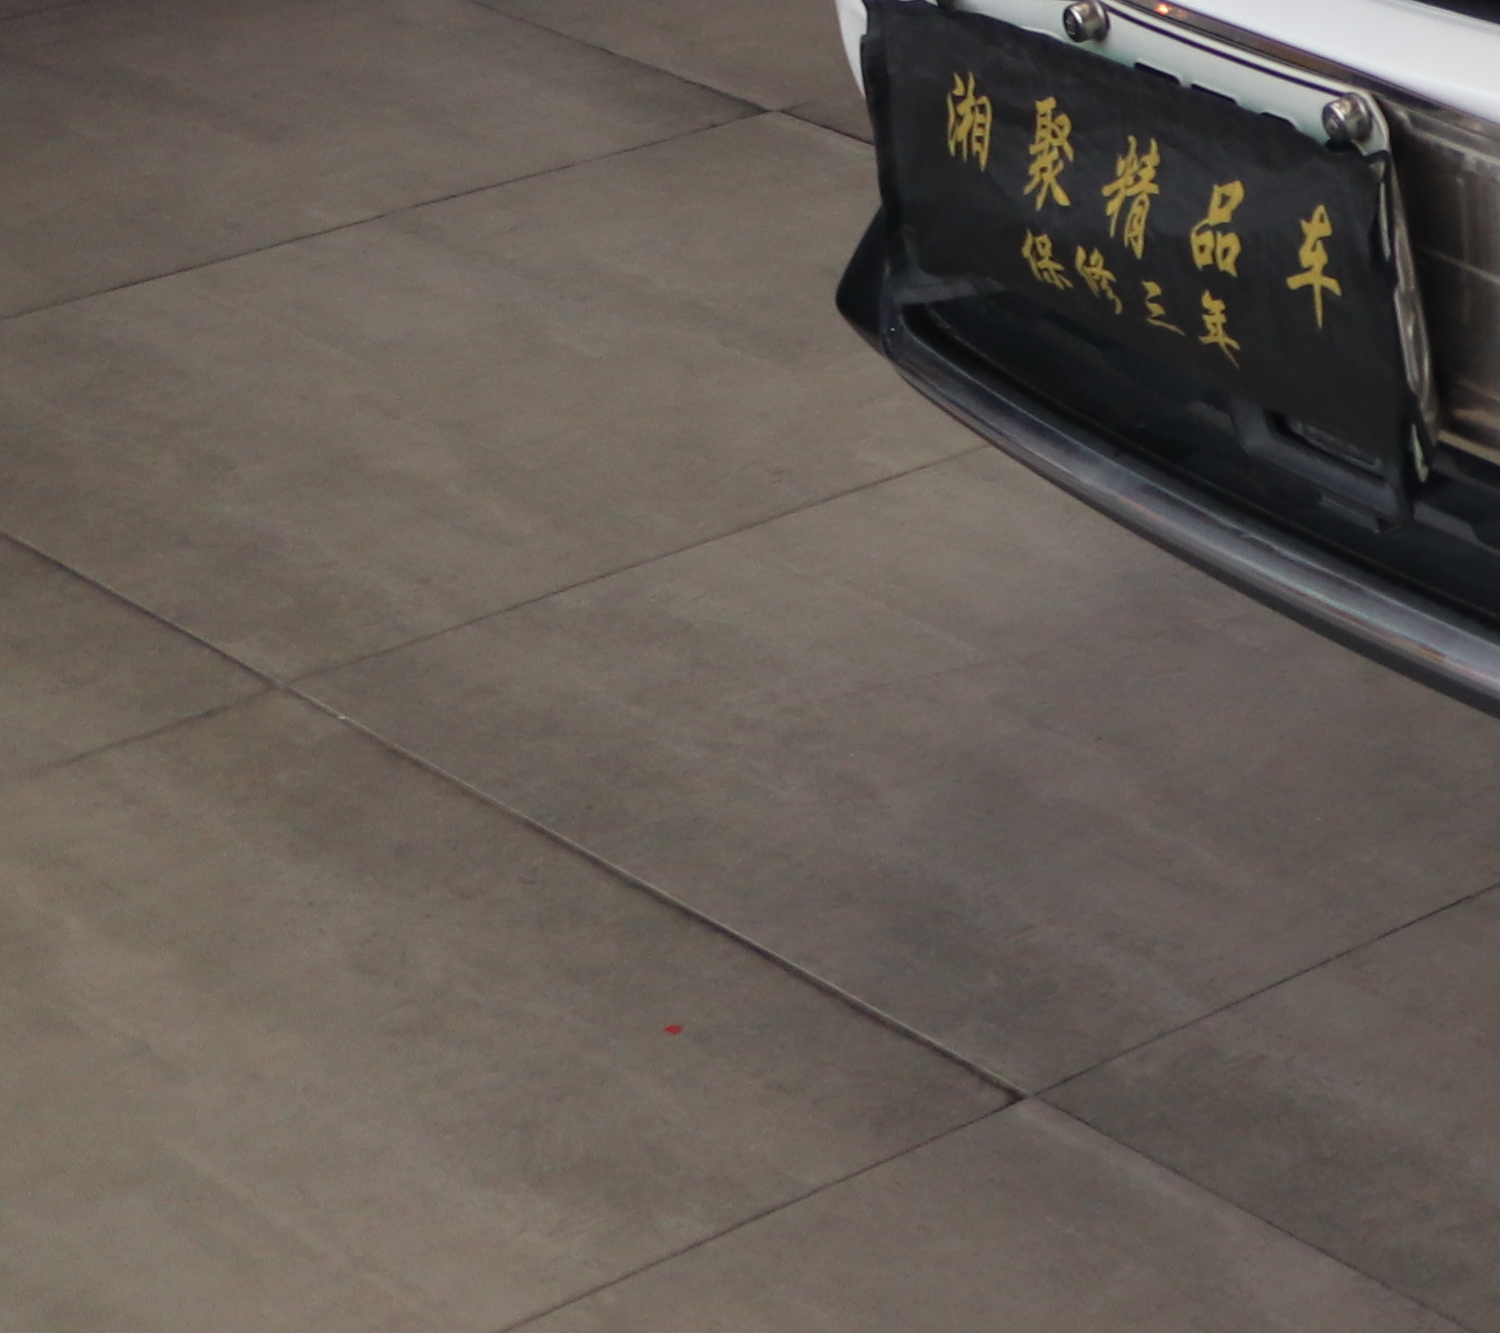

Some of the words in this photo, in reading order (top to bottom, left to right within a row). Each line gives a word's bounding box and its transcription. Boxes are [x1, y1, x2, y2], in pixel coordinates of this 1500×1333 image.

[945, 70, 1343, 329] 湘聚精品车
[1020, 228, 1243, 369] 保修三年
